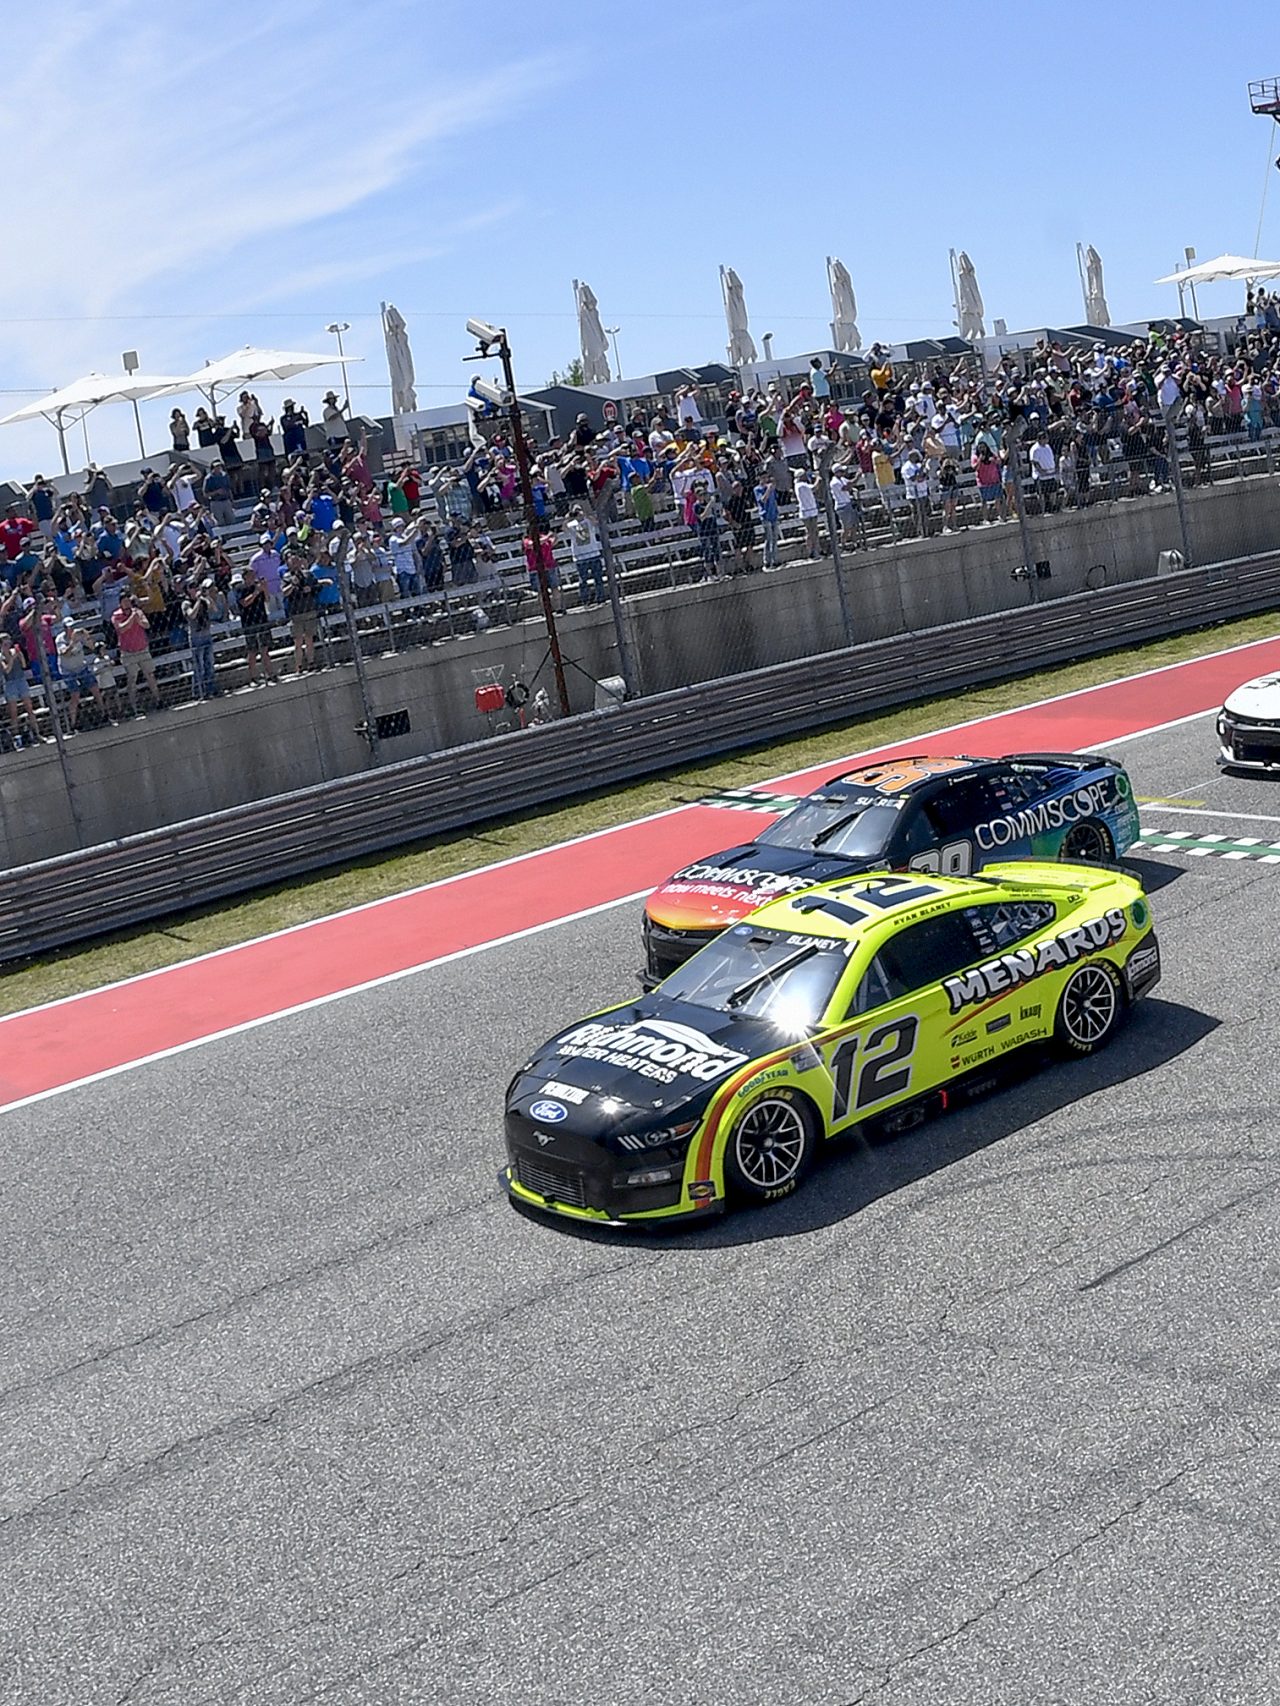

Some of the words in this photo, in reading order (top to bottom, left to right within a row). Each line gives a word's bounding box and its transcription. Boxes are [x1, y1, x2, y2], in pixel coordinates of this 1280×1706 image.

[975, 781, 1108, 851] COMMSCOPE
[690, 884, 733, 900] meets
[920, 902, 951, 916] BLANEY
[787, 935, 841, 950] BLANEY
[944, 908, 1127, 1014] MENARDS
[557, 1022, 746, 1082] Richmond
[1001, 1027, 1048, 1050] WABASH
[602, 1052, 679, 1084] HEATERS
[830, 1014, 920, 1124] 12
